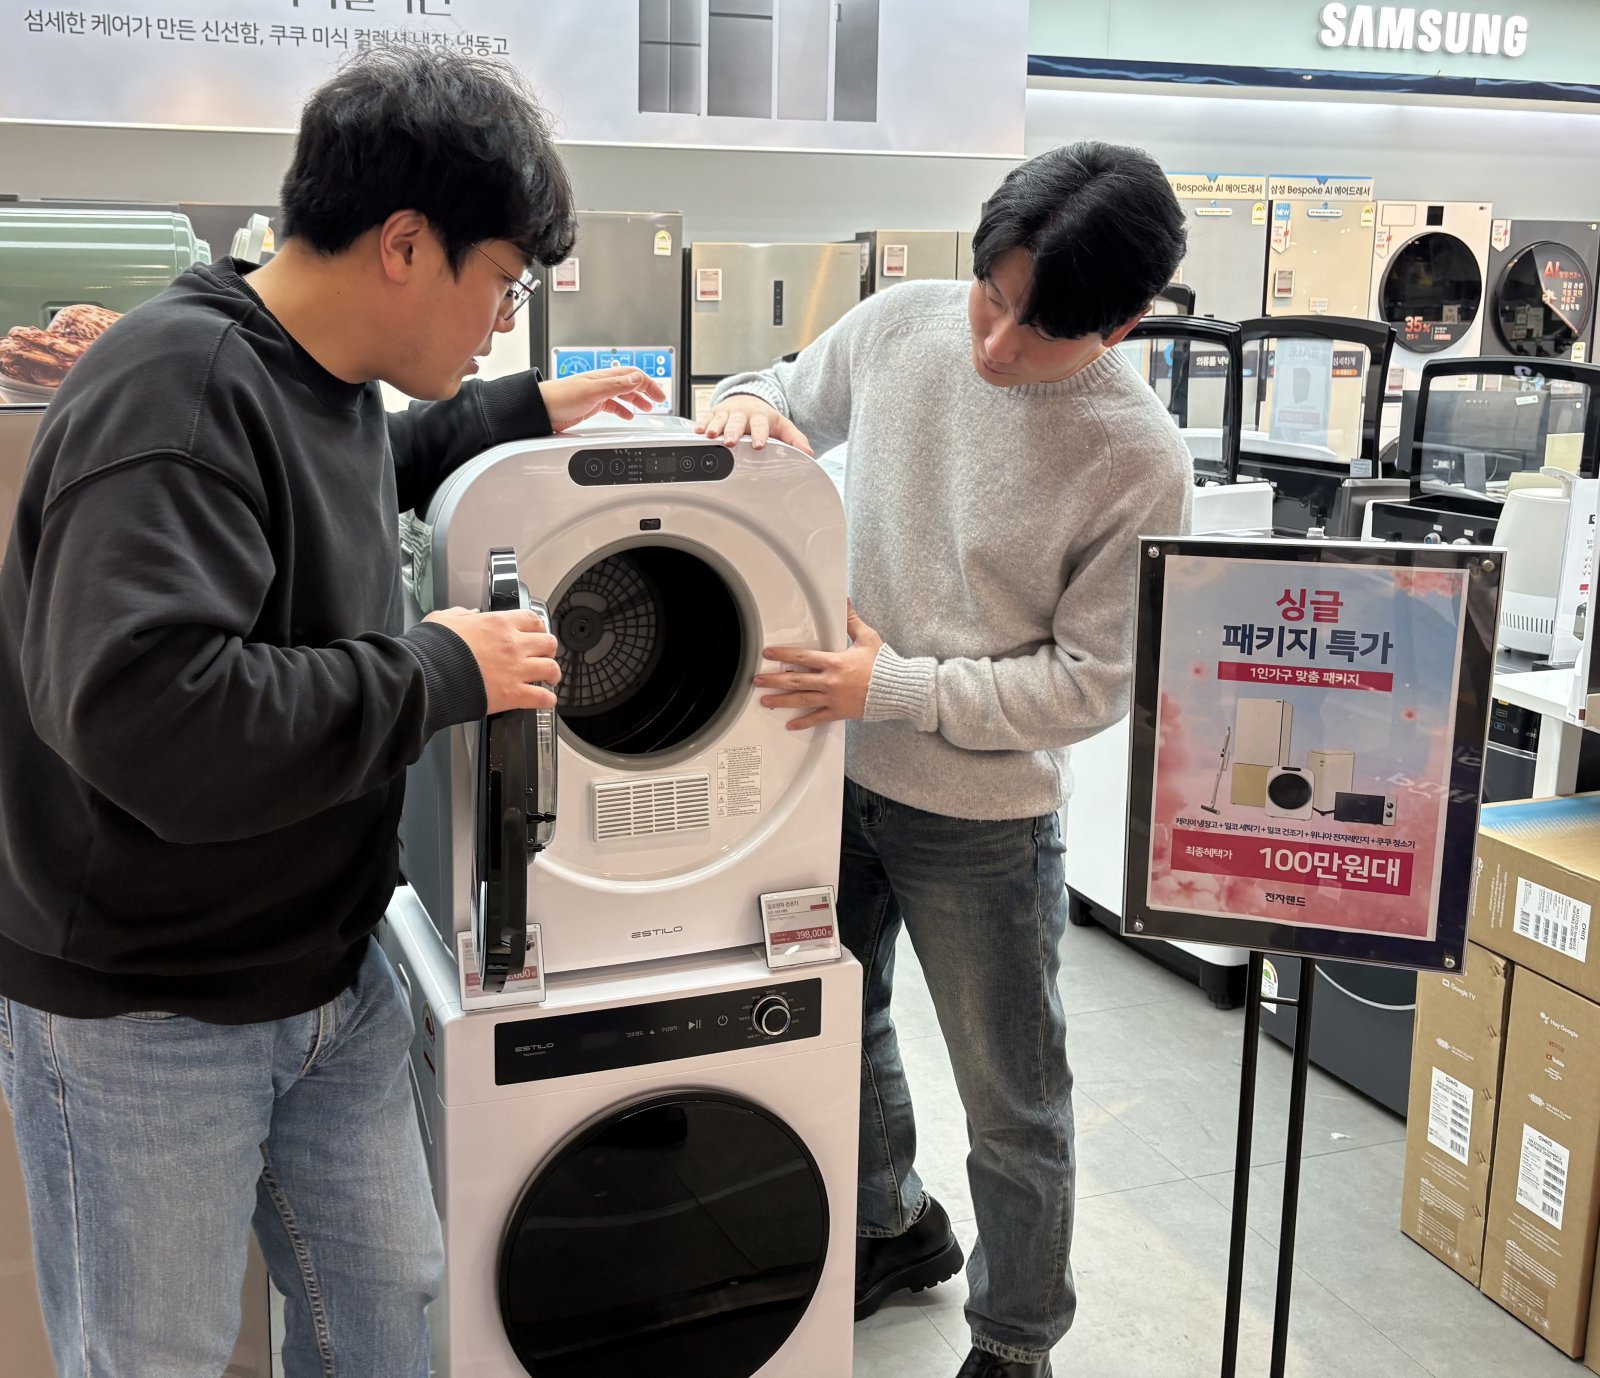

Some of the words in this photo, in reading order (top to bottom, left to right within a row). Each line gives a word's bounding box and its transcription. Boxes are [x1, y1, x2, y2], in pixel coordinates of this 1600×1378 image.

[24, 9, 86, 34] 섬세한
[91, 14, 152, 38] 케어가
[157, 18, 196, 41] 만든
[201, 20, 264, 46] 신선함,
[269, 24, 307, 46] 쿠쿠
[313, 27, 348, 49] 미식
[1320, 2, 1528, 58] SAMSUNG
[1176, 183, 1213, 194] Bespoke
[1215, 184, 1223, 192] AI
[1271, 184, 1285, 195] 삼성
[1287, 185, 1323, 197] Bespoke
[1325, 187, 1332, 195] AI
[1334, 186, 1370, 197] 에어드레서
[1275, 208, 1290, 217] NEW
[1276, 588, 1344, 624] 싱글
[1222, 623, 1318, 660] 패키지
[1325, 629, 1394, 665] 특가
[1250, 667, 1293, 682] 1인가구
[1295, 669, 1319, 684] 맞춤
[1322, 671, 1360, 687] 패키지
[1282, 827, 1304, 838] 건조기
[1310, 830, 1332, 840] 위니아
[1333, 833, 1370, 844] 전자레인지
[1376, 837, 1392, 847] 쿠쿠
[1392, 839, 1415, 848] 청소기
[1185, 845, 1233, 860] 최종혜택가
[1259, 847, 1401, 887] 100만원대
[1265, 892, 1306, 907] 전자랜드
[631, 925, 683, 939] ESTILO
[796, 928, 827, 940] 398,000
[1450, 983, 1468, 998] Google
[1469, 992, 1476, 1000] TV
[1560, 1025, 1578, 1039] Google
[515, 1042, 555, 1053] ESTILO
